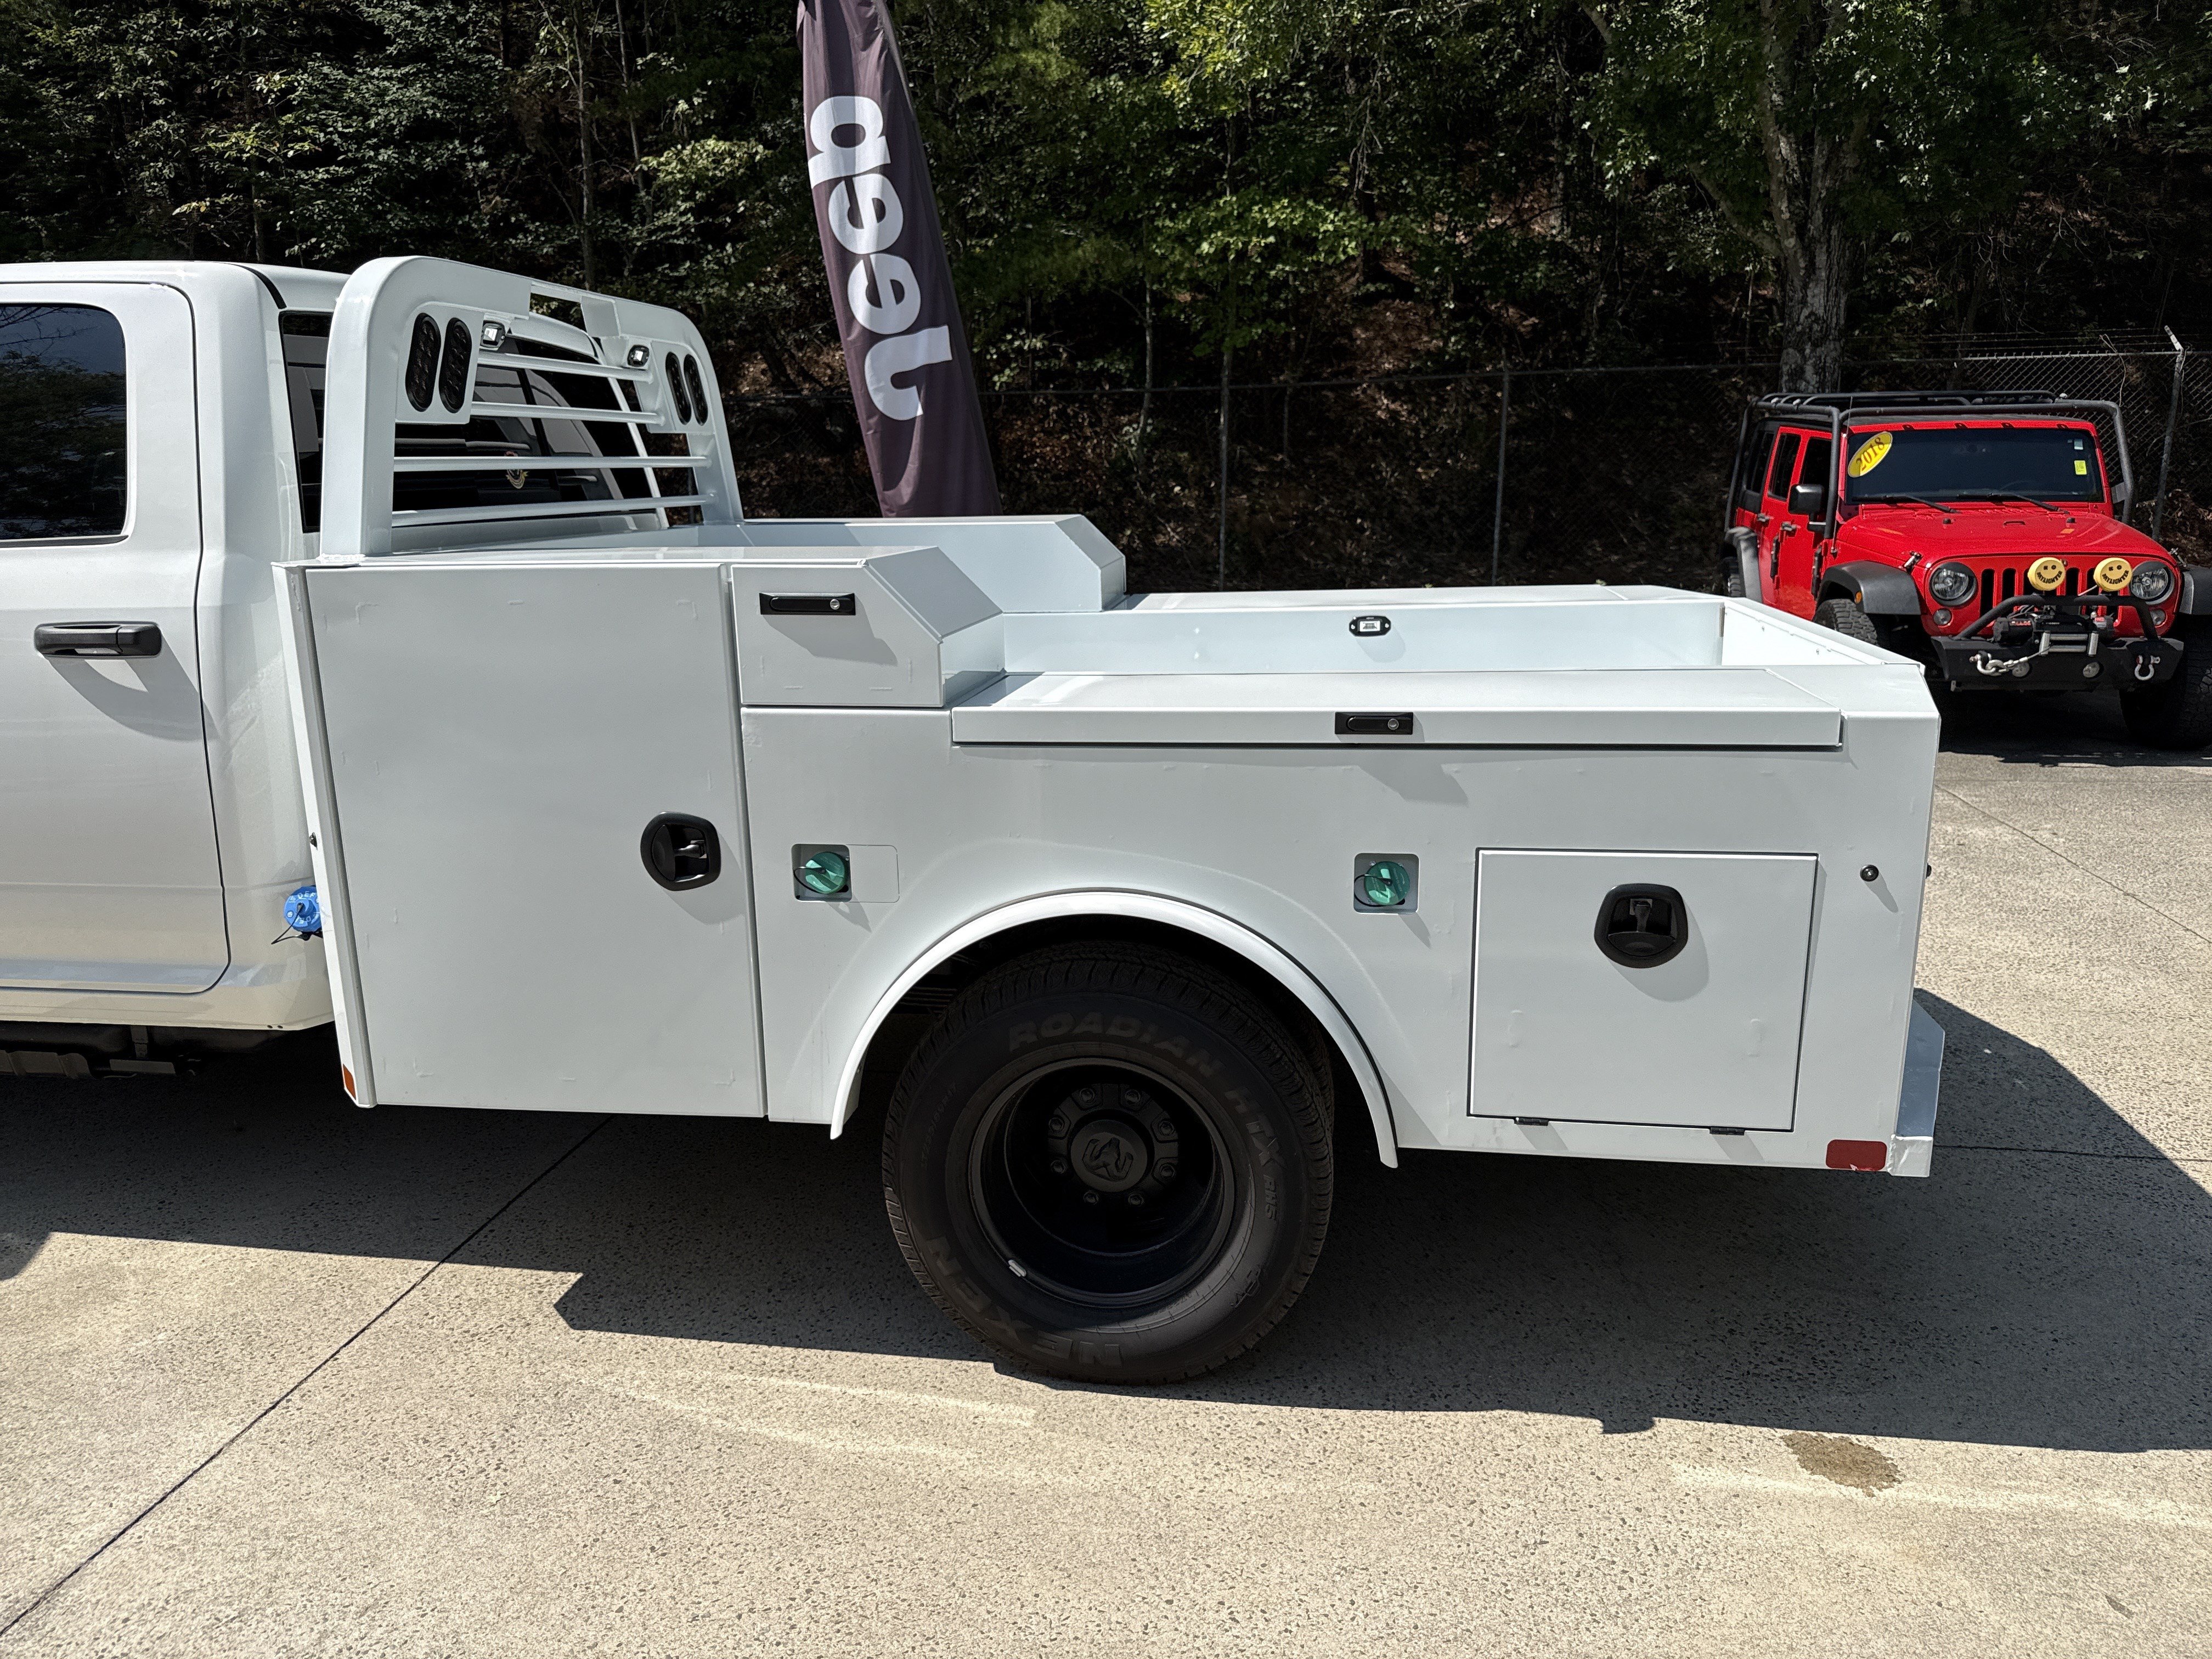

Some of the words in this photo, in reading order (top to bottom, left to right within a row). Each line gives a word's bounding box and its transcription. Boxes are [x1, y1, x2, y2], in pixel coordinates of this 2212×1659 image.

[1855, 437, 1885, 471] 2018
[1008, 1012, 1223, 1077] ROADIAN
[1226, 1088, 1285, 1170] HTX
[929, 1237, 1123, 1368] NEXEN
